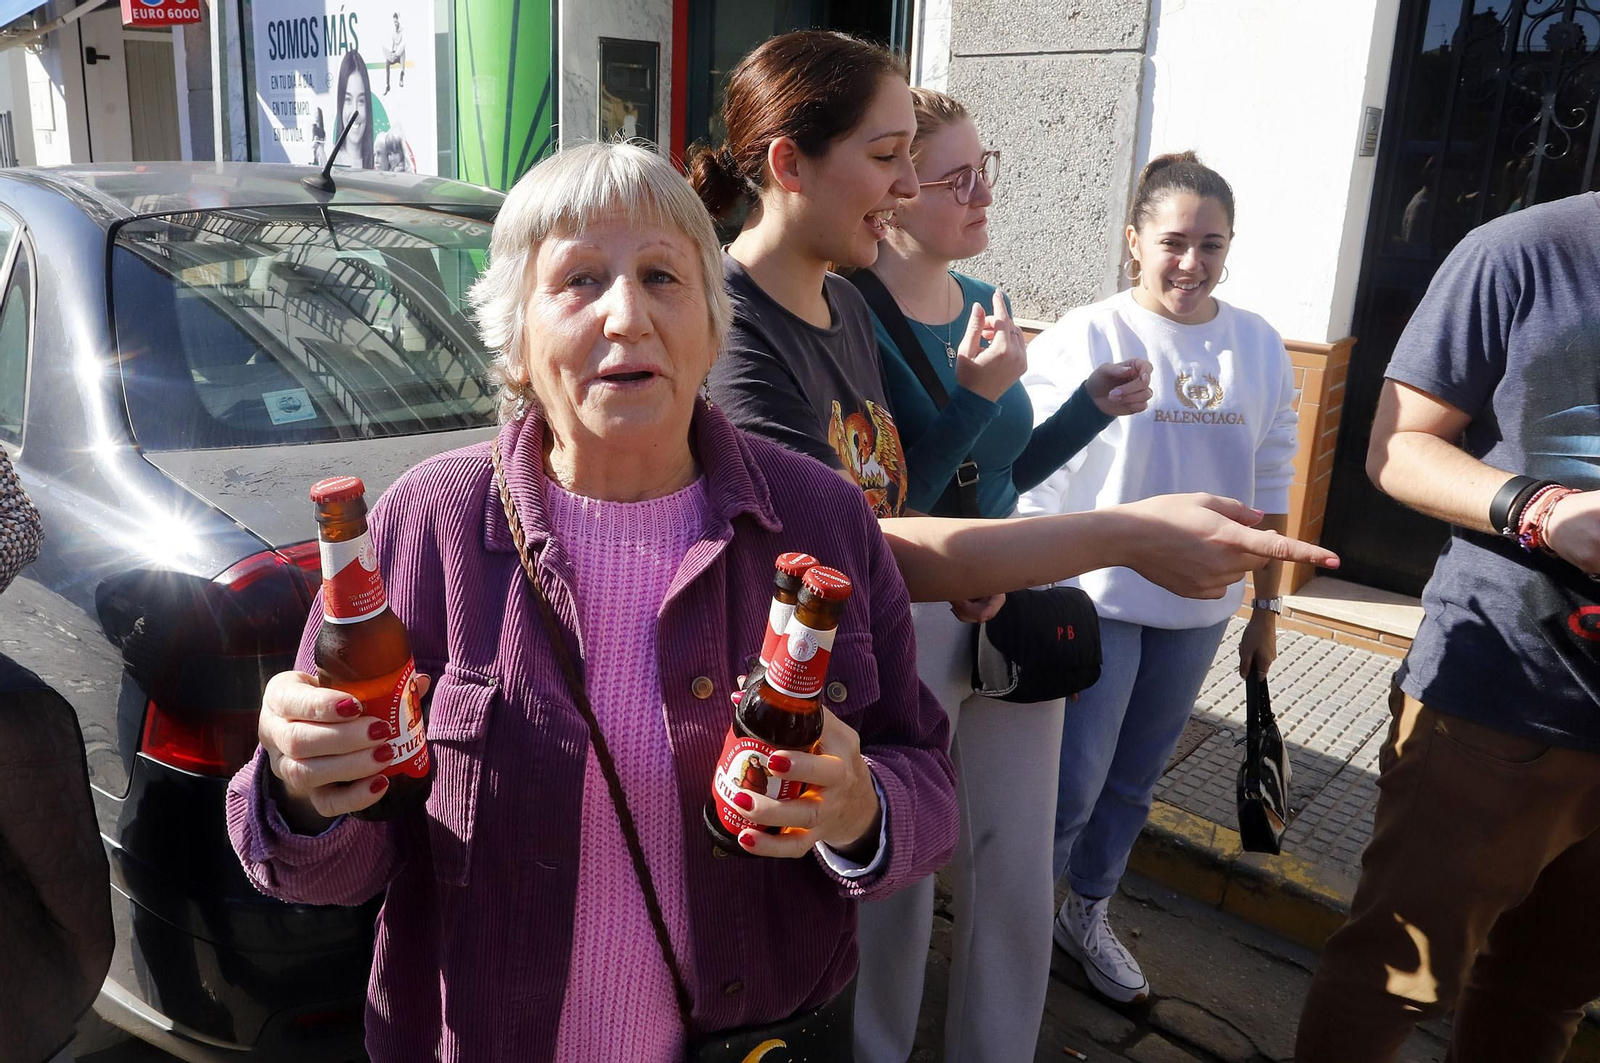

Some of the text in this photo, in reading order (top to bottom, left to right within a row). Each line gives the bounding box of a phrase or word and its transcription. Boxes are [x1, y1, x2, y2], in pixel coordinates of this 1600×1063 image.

[132, 8, 199, 19] EURO 6000
[267, 4, 359, 61] SOMOS MÁS
[272, 101, 280, 116] EN
[280, 101, 288, 116] TU
[1154, 409, 1245, 425] BALENCIAGA
[810, 568, 851, 586] Cruzcampo
